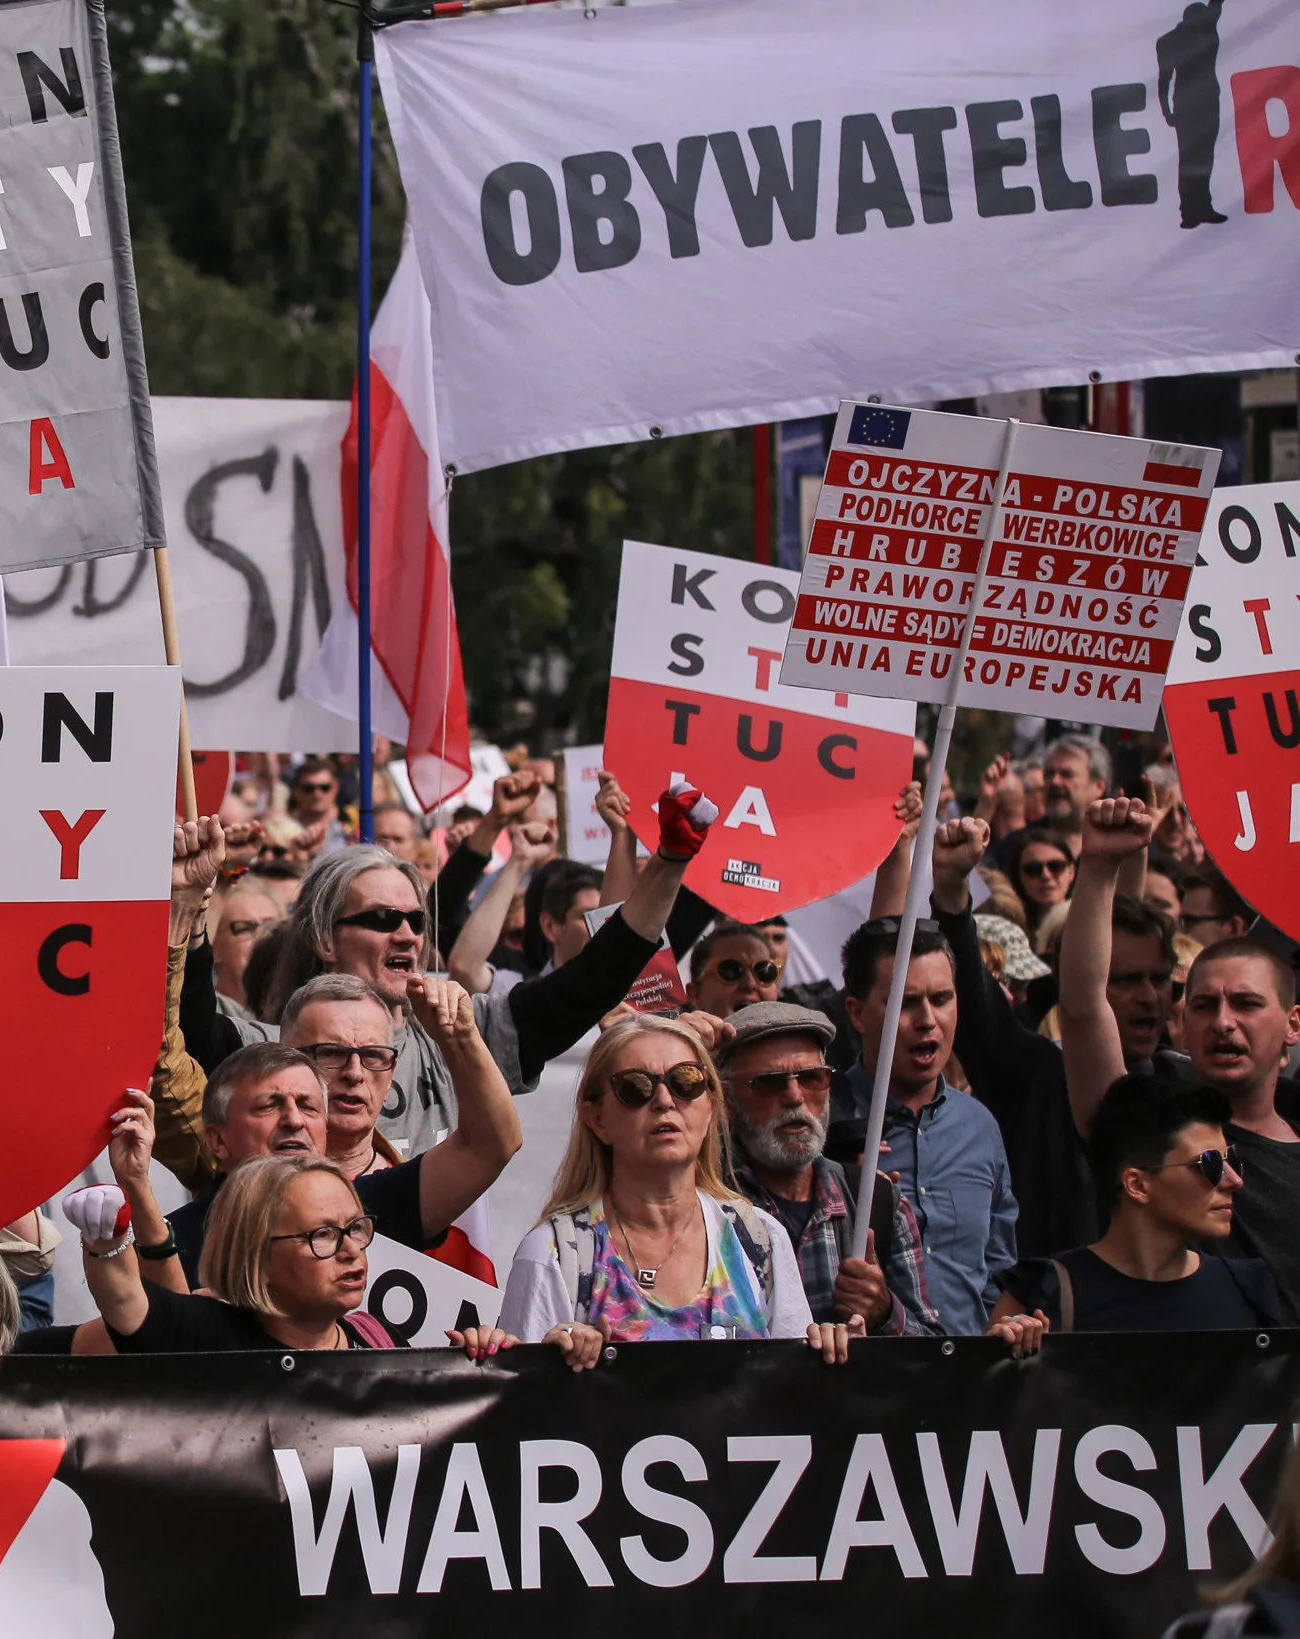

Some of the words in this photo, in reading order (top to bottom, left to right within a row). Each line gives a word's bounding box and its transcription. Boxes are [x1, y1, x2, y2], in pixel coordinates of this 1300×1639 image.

[480, 82, 1159, 286] OBYWATELE
[1230, 64, 1300, 215] R
[838, 492, 982, 535] PODHORCE
[1003, 512, 1179, 561] WERBKOWICE
[847, 459, 1021, 507] OJCZYZNA
[1052, 484, 1182, 527] POLSKA
[670, 563, 797, 625] KO
[824, 564, 1159, 629] PRAWORZĄDNOŚĆ
[831, 528, 1170, 597] HRUBESZÓW
[814, 600, 899, 634] WOLNE
[903, 611, 966, 645] SĄDY
[991, 622, 1151, 666] DEMOKRACJA
[1188, 594, 1300, 663] ST
[805, 637, 891, 673] UNIA
[905, 650, 1142, 704] EUROPEJSKA
[664, 698, 858, 780] TUC
[273, 1423, 1300, 1596] WARSZAWSK
